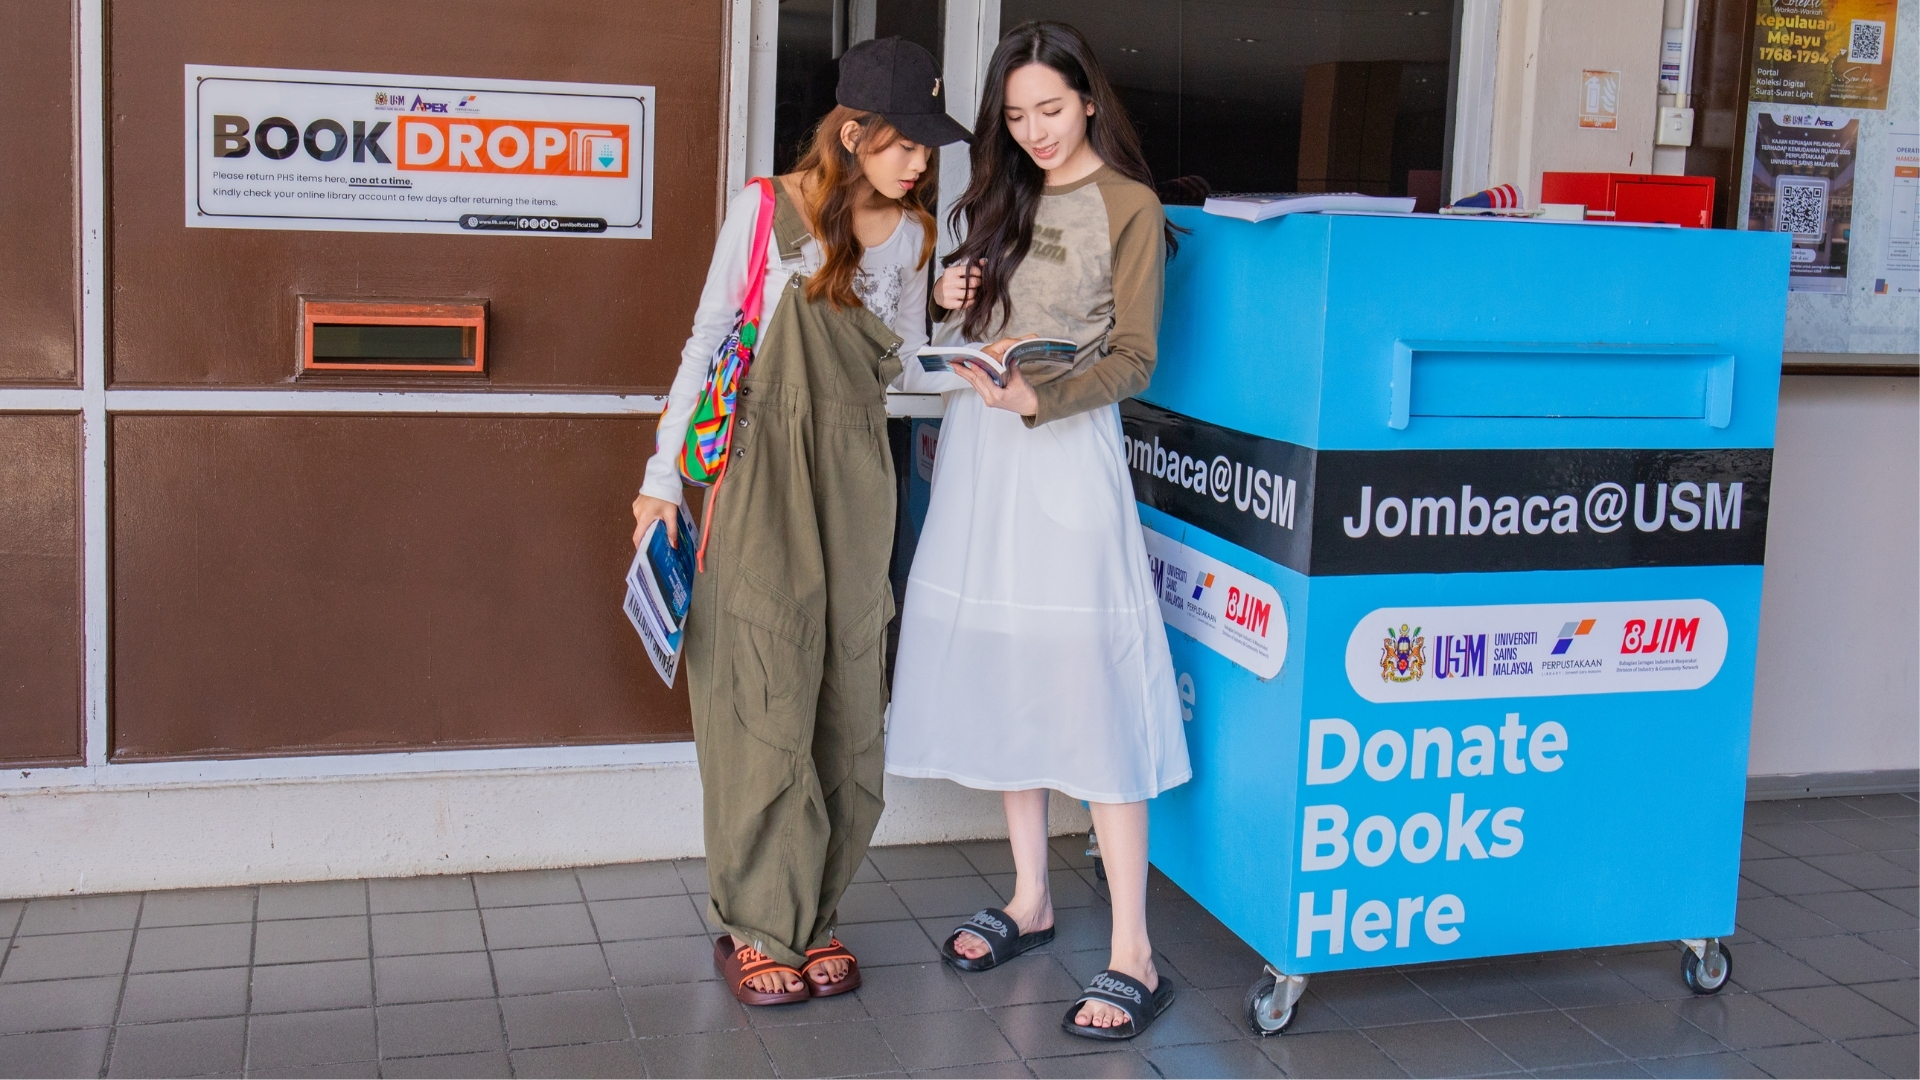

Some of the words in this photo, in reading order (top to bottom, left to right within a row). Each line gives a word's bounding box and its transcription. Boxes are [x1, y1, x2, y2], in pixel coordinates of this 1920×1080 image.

[1756, 14, 1836, 31] Kepulauan
[1768, 31, 1820, 49] Melayu
[1760, 47, 1829, 64] 1768-1794
[1758, 68, 1779, 76] Portal
[1756, 78, 1781, 86] Koleksi
[1783, 80, 1806, 88] Digital
[1756, 88, 1794, 97] Surat-Surat
[1796, 90, 1814, 99] Light
[410, 94, 448, 113] APEX
[213, 114, 393, 164] BOOK
[404, 122, 567, 169] DROP
[213, 171, 244, 180] Please
[246, 173, 274, 181] return
[297, 174, 322, 182] items
[325, 175, 347, 184] here,
[389, 177, 413, 185] time.
[213, 188, 241, 198] Kindly
[243, 189, 271, 198] check
[297, 191, 325, 199] online
[327, 191, 356, 201] library
[426, 194, 447, 204] days
[473, 196, 513, 206] returning
[532, 198, 558, 206] items.
[1124, 435, 1296, 530] ombaca@USM
[1343, 482, 1743, 538] Jombaca@USM
[1187, 602, 1216, 623] PERPUSTAKAAN
[1435, 634, 1486, 679] USM
[1494, 632, 1538, 646] UNIVERSITI
[1494, 648, 1517, 661] SAINS
[1493, 662, 1533, 676] MALAYSIA
[1542, 659, 1602, 670] PERPUSTAKAAN
[1306, 712, 1568, 786] Donate
[1301, 793, 1525, 872] Books
[1296, 889, 1465, 958] Here
